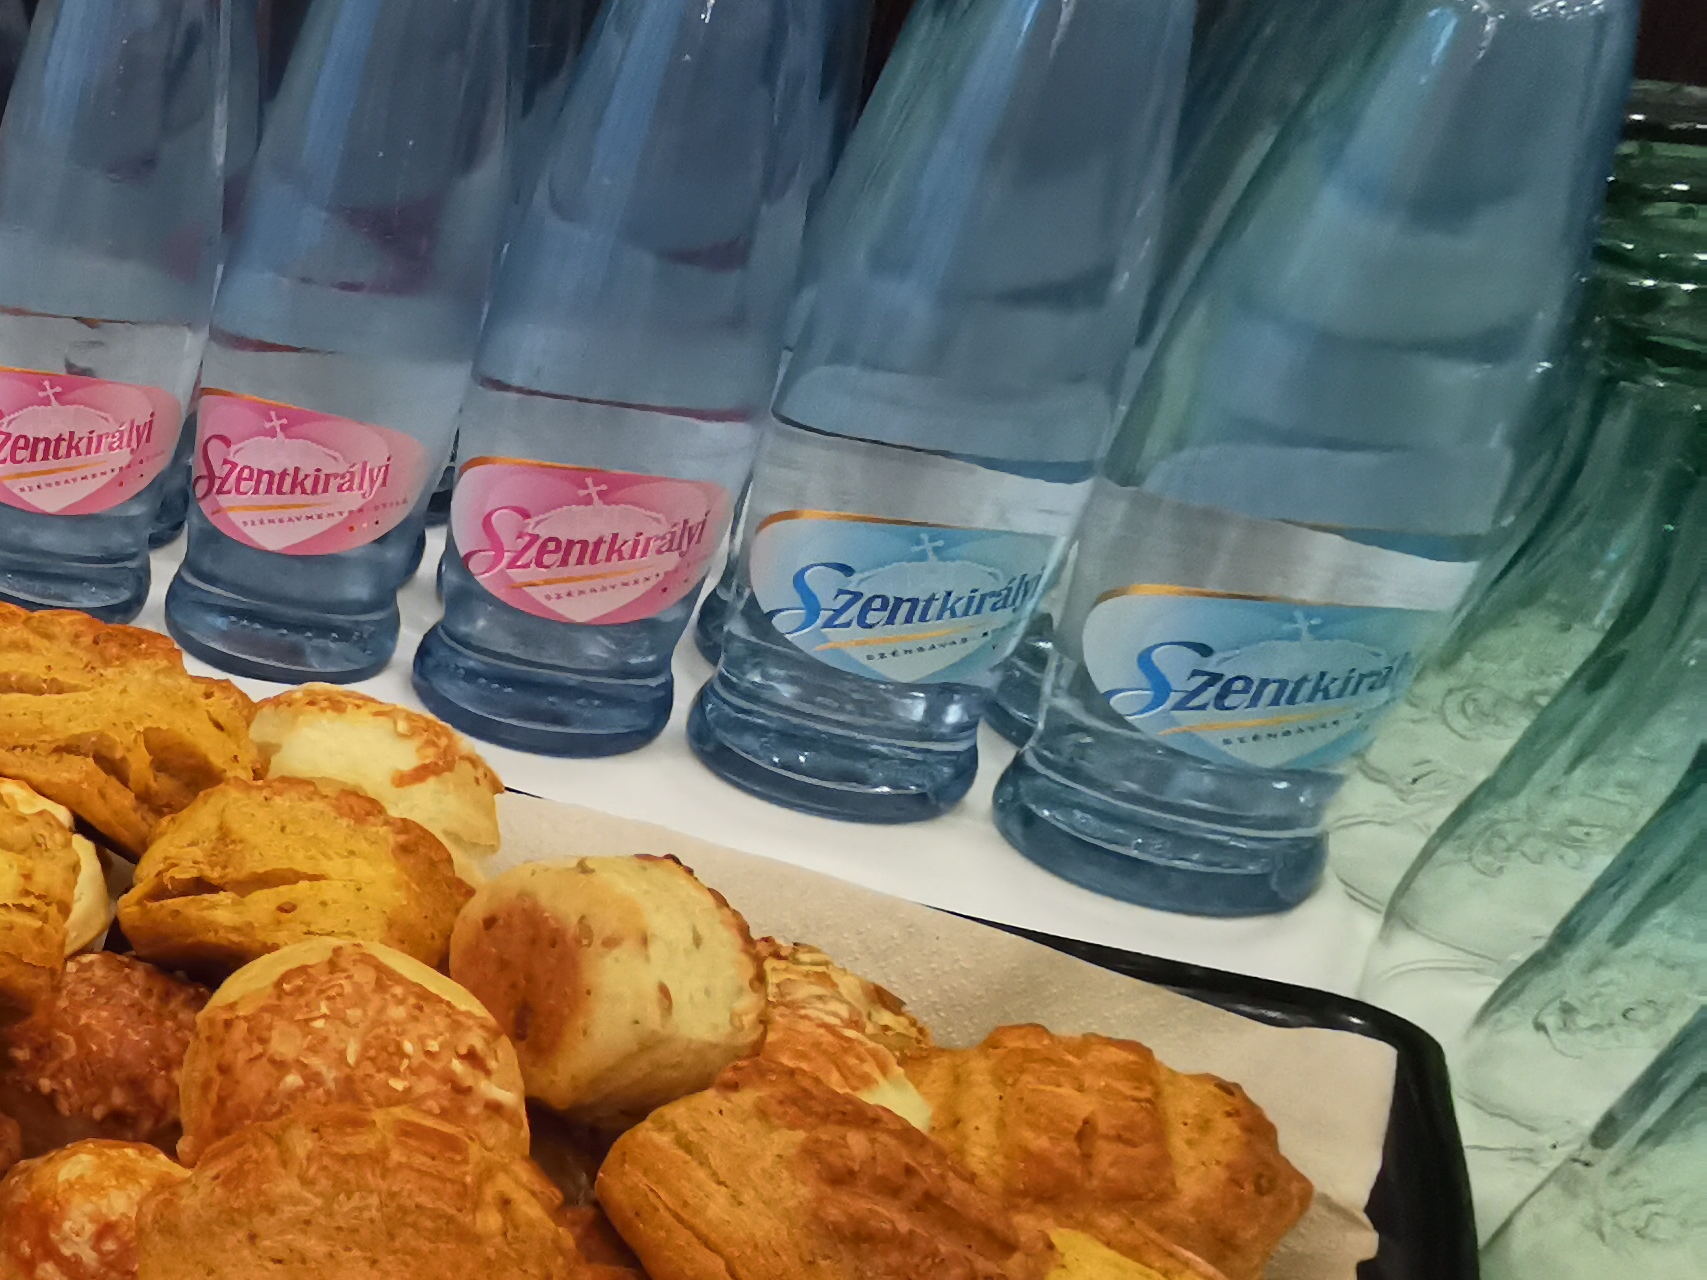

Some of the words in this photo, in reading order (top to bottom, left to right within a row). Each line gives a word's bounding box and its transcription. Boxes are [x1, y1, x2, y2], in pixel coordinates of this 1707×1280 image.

[192, 434, 393, 503] Szentkirályi
[461, 509, 712, 577] Szentkirályi
[1101, 640, 1411, 719] Szentkirál
